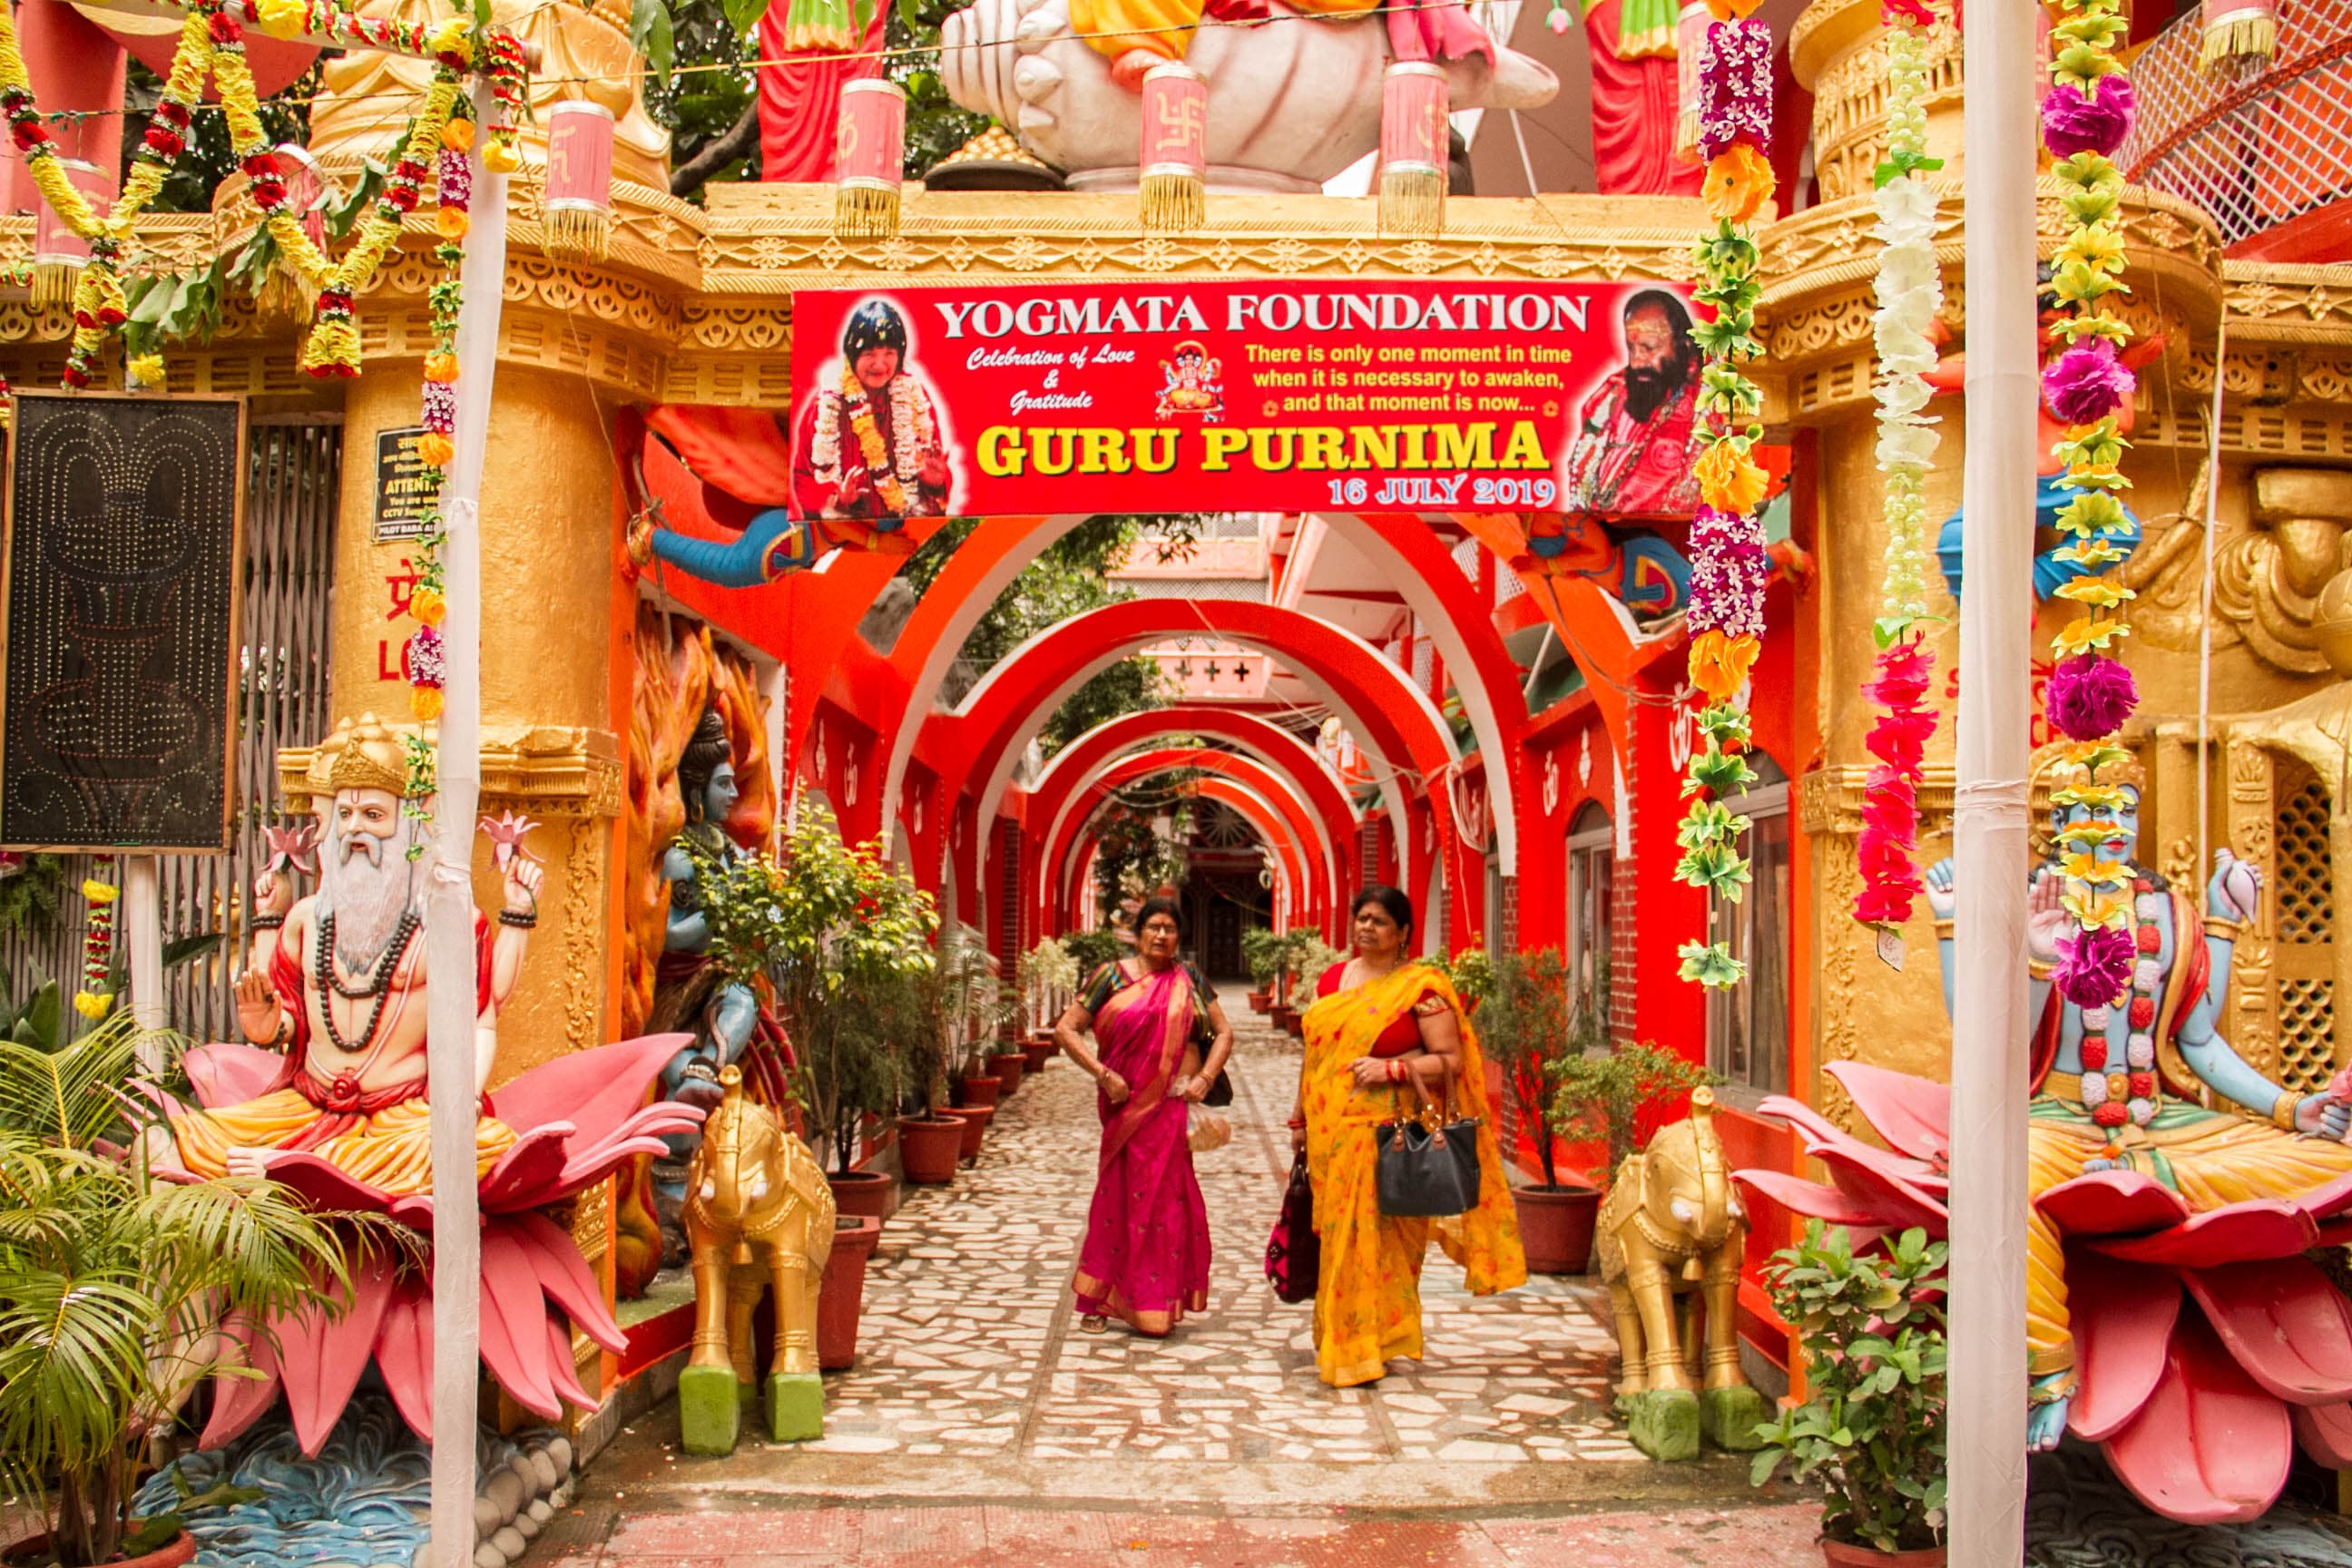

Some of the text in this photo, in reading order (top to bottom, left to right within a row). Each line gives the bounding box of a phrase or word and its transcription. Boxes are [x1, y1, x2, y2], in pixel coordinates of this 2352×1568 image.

[933, 292, 1591, 338] YOGMATA FOUNDATION
[966, 343, 1136, 371] Celebration of Love
[1244, 344, 1573, 367] There is only one moment in time
[1043, 368, 1059, 389] &
[1253, 368, 1564, 391] when it is necessary to awaken,
[1010, 389, 1093, 416] Gratitude
[1283, 393, 1536, 411] and that moment is now...
[976, 420, 1551, 477] GURU PURNIMA
[385, 477, 439, 495] ATTENT
[1328, 473, 1556, 508] 16 JULY 2019
[382, 507, 403, 518] CCTV
[389, 496, 406, 506] You
